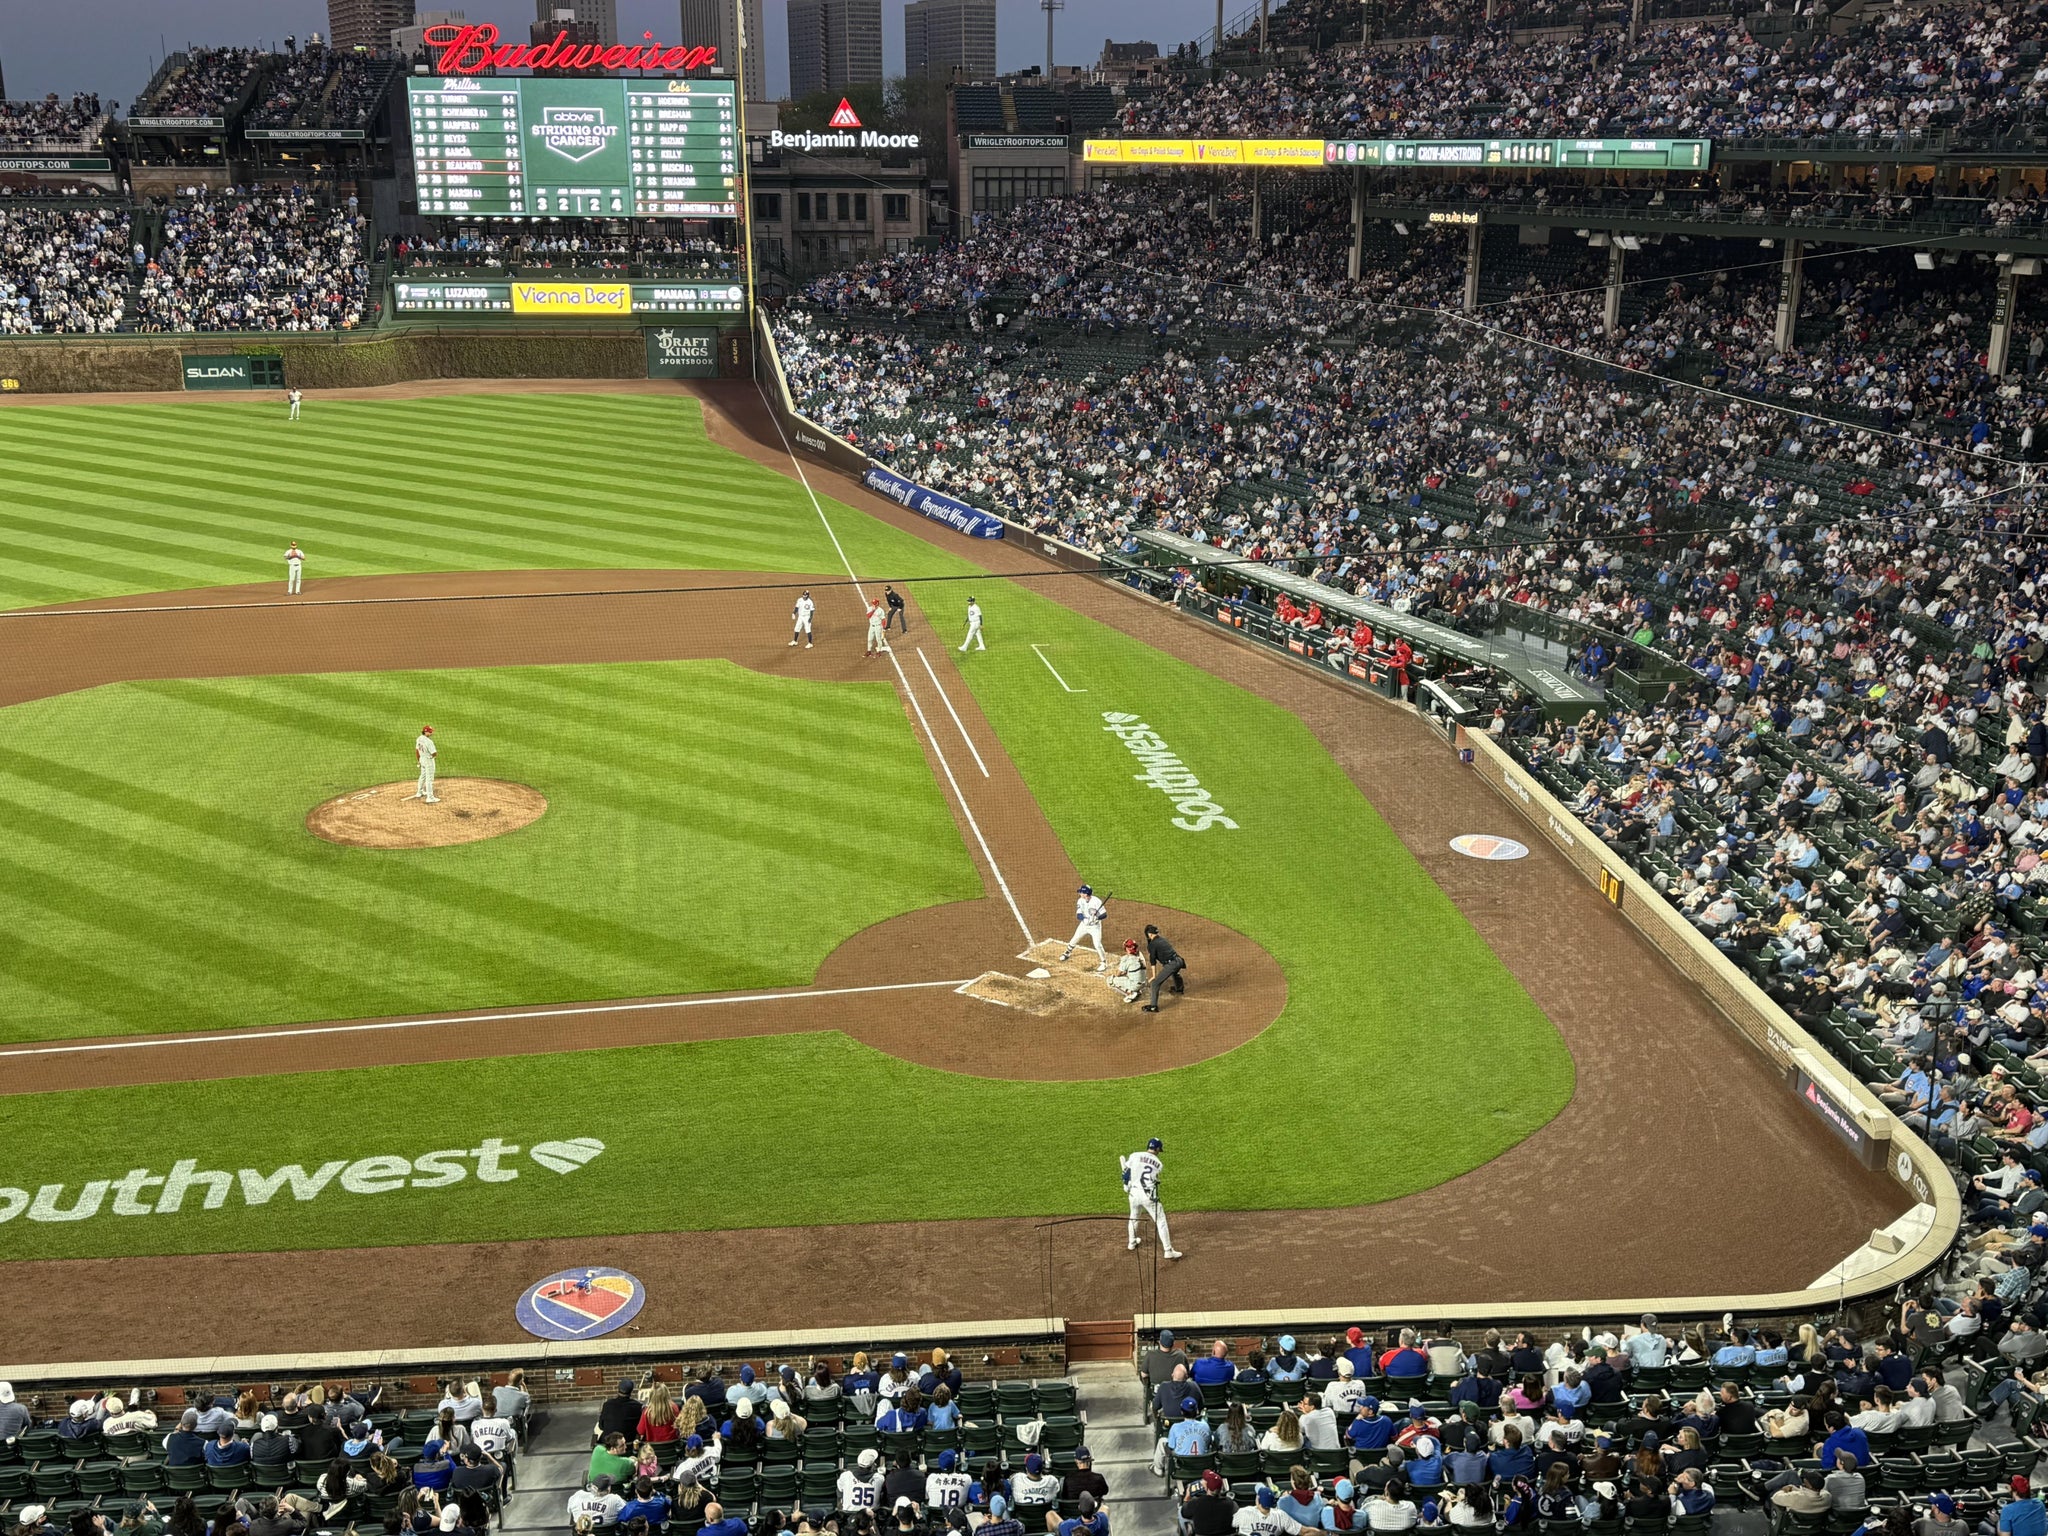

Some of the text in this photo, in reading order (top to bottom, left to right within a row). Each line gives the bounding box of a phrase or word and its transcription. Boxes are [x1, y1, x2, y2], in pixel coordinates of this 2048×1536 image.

[424, 23, 718, 74] Budweiser
[444, 78, 481, 90] Phillies
[668, 80, 691, 92] Cubs
[554, 112, 594, 122] abbvie
[532, 125, 619, 136] STRIKING OUT
[551, 136, 601, 146] CANCER
[771, 130, 919, 150] Benjamin Moore
[1418, 146, 1482, 161] CROW-ARMSTRONG
[0, 160, 70, 169] OOFTOPS.COM
[537, 197, 622, 211] 3 2 2 4
[1445, 211, 1462, 223] suite
[1462, 212, 1478, 223] level
[445, 288, 488, 298] LUZARDO
[518, 287, 625, 309] Vienna Beef
[659, 337, 709, 349] DRAFT
[666, 347, 708, 357] KINGS
[867, 472, 906, 504] Reynolds Wrap
[920, 496, 968, 530] Reynolds Wrap
[1102, 723, 1240, 831] Southwest
[1816, 1094, 1859, 1142] Benjamin Moore
[1190, 1441, 1199, 1455] 4
[852, 1487, 875, 1506] 35
[940, 1490, 960, 1506] 18
[582, 1501, 607, 1513] LAUER
[1251, 1523, 1278, 1534] LESTER
